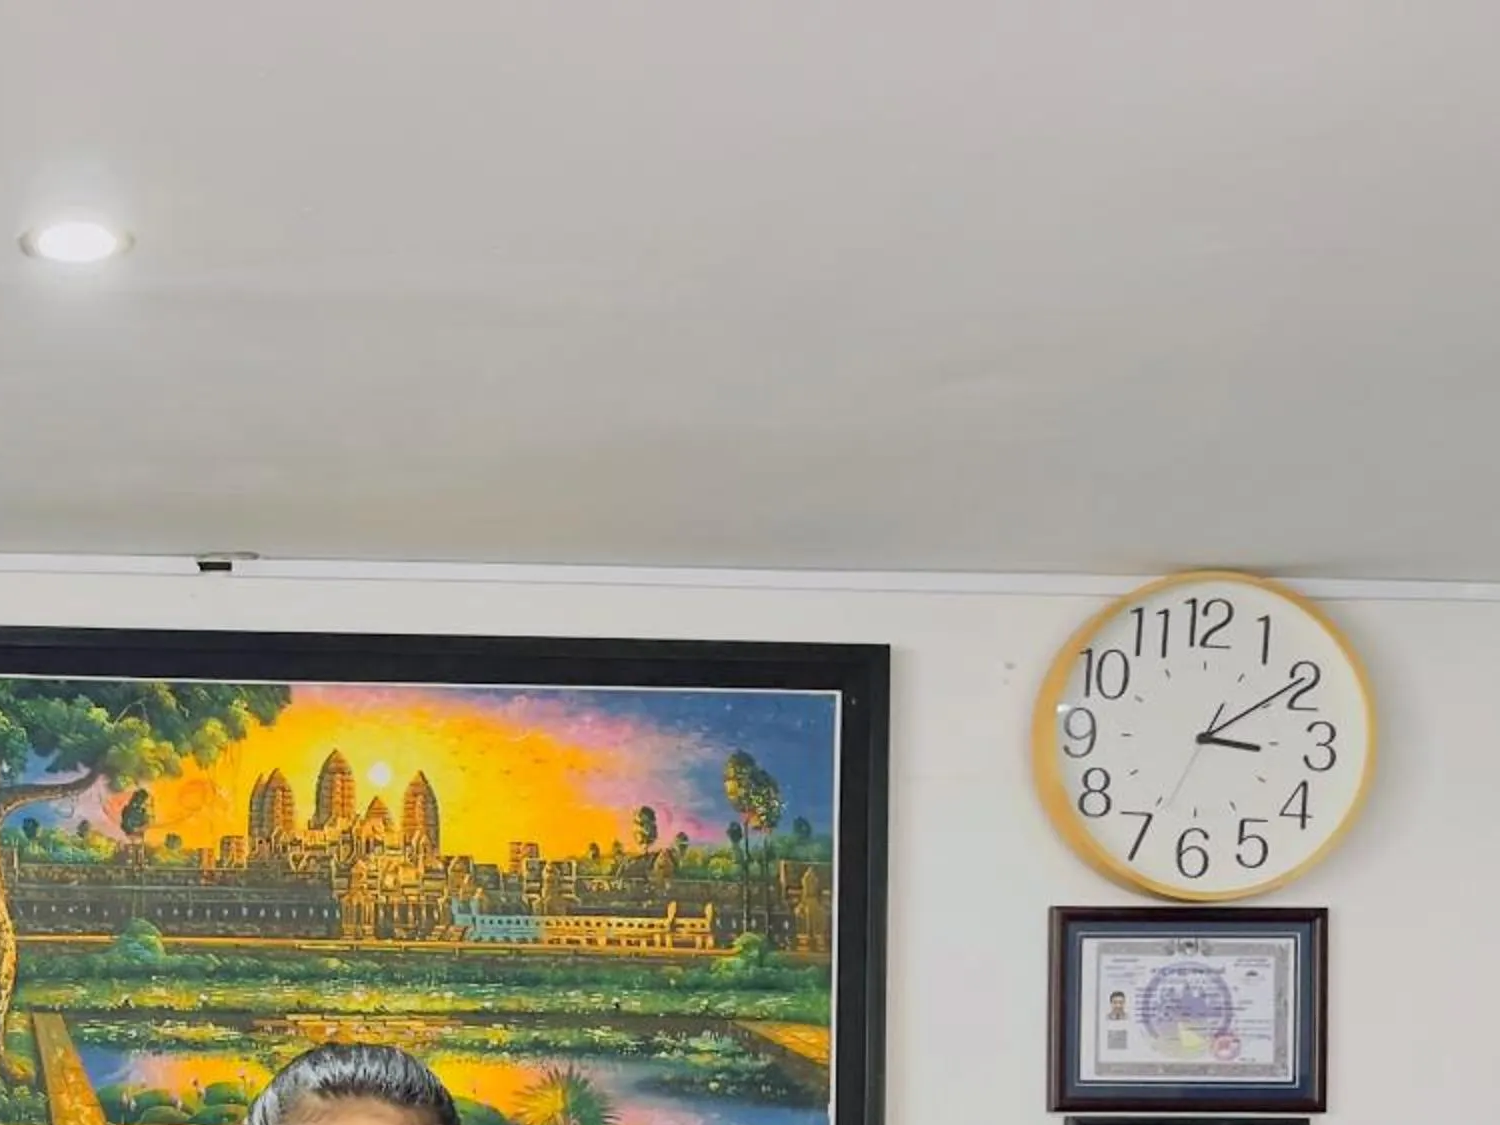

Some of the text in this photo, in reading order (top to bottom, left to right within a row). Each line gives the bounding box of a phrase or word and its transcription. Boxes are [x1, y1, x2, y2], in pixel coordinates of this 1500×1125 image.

[1130, 607, 1170, 658] 11
[1184, 598, 1234, 649] 12
[1256, 615, 1270, 665] 1
[1080, 648, 1130, 700] 10
[1287, 661, 1321, 712] 2
[1063, 707, 1096, 758] 9
[1303, 721, 1337, 772] 3
[1077, 767, 1112, 818] 8
[1279, 780, 1313, 830] 4
[1120, 810, 1153, 861] 7
[1176, 827, 1209, 878] 6
[1235, 818, 1269, 868] 5
